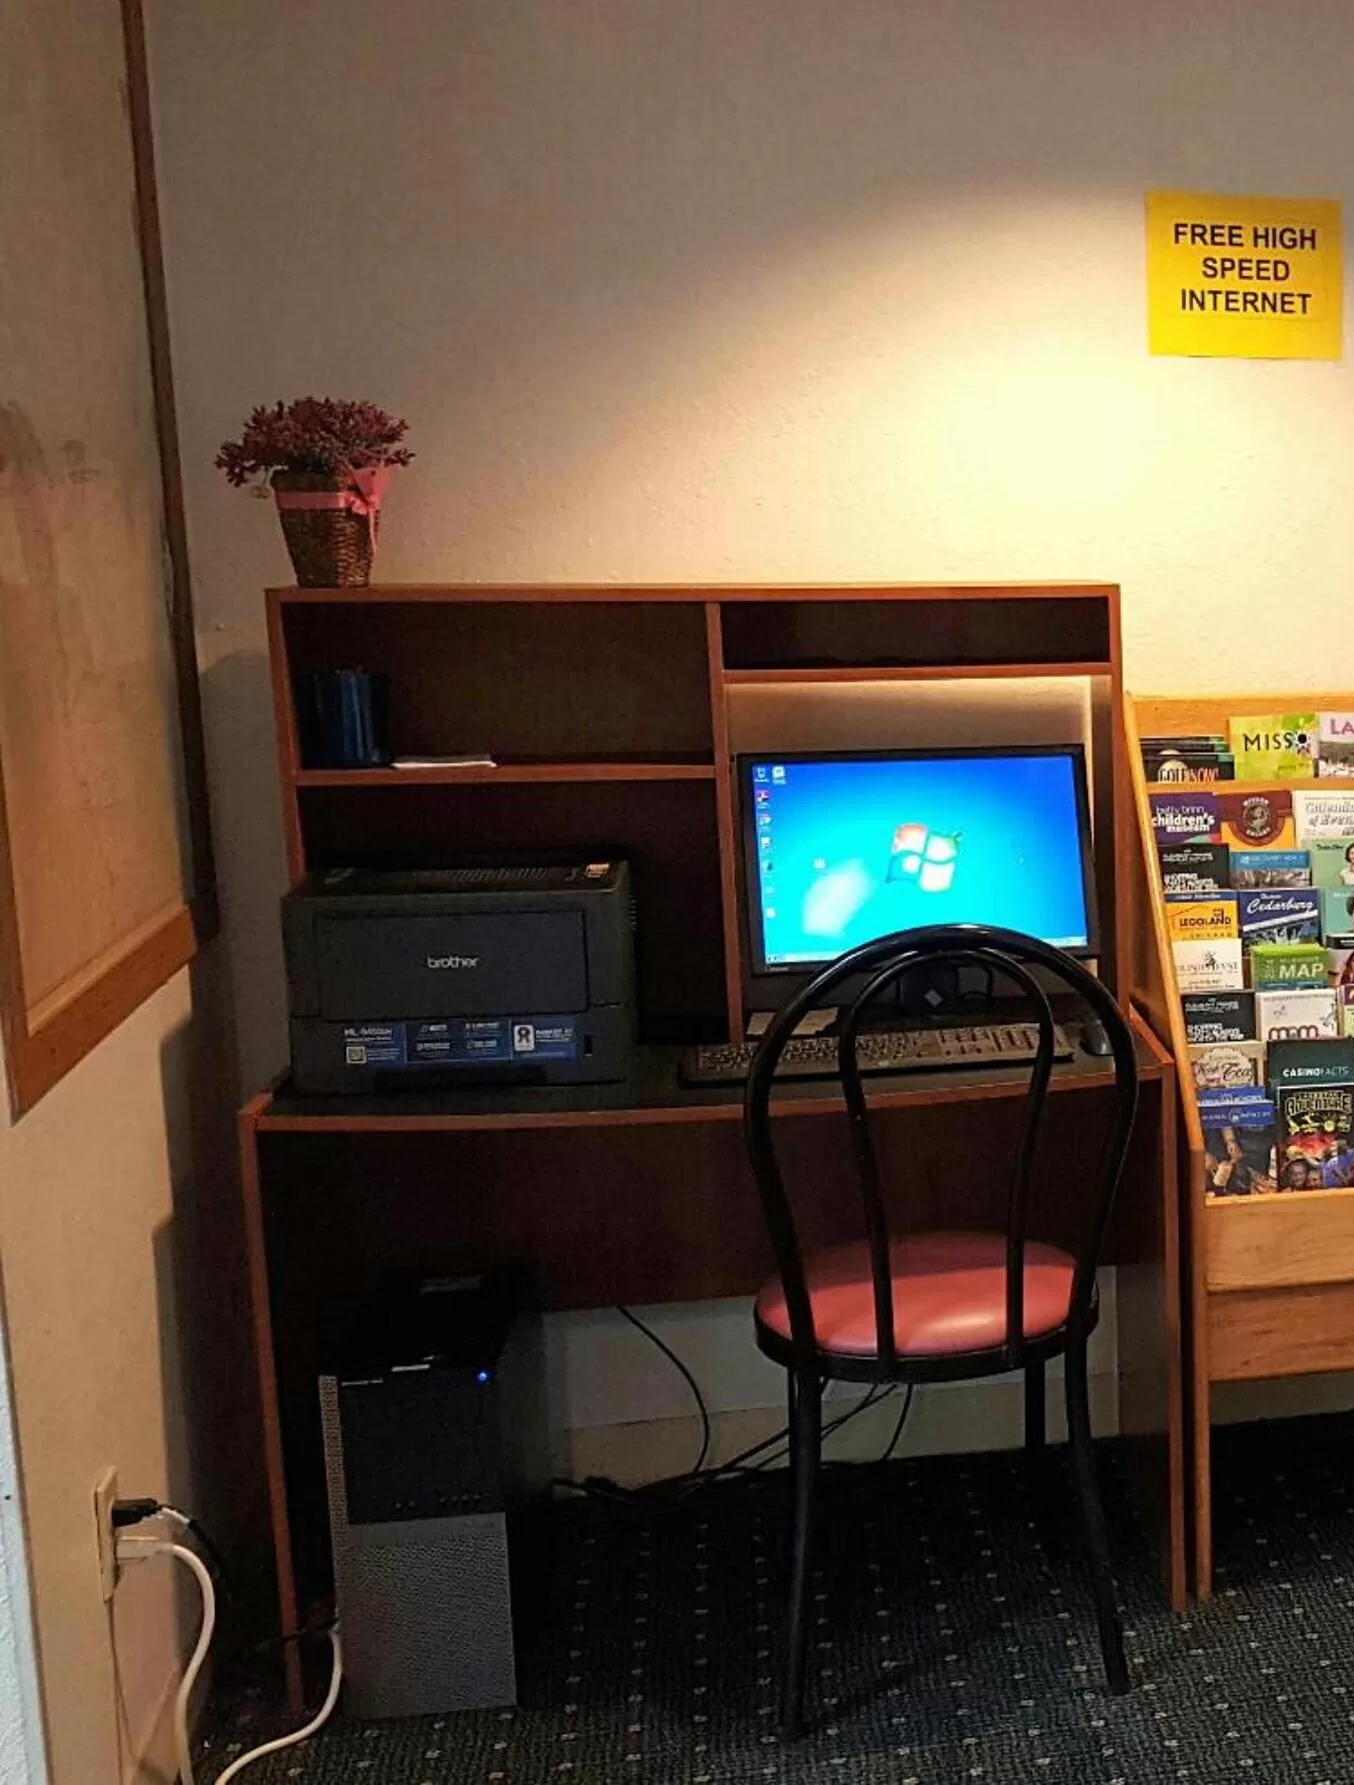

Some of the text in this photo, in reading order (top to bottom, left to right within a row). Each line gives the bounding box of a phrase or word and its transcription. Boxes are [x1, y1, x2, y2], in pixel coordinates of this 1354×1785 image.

[1174, 223, 1316, 250] FREE HIGH
[1202, 257, 1290, 281] SPEED
[1181, 289, 1312, 314] INTERNET
[1152, 813, 1216, 827] children's
[1247, 897, 1314, 915] Cedarburg
[1180, 913, 1232, 928] LEGOLAND
[427, 956, 481, 969] brother
[1279, 963, 1324, 979] MAP
